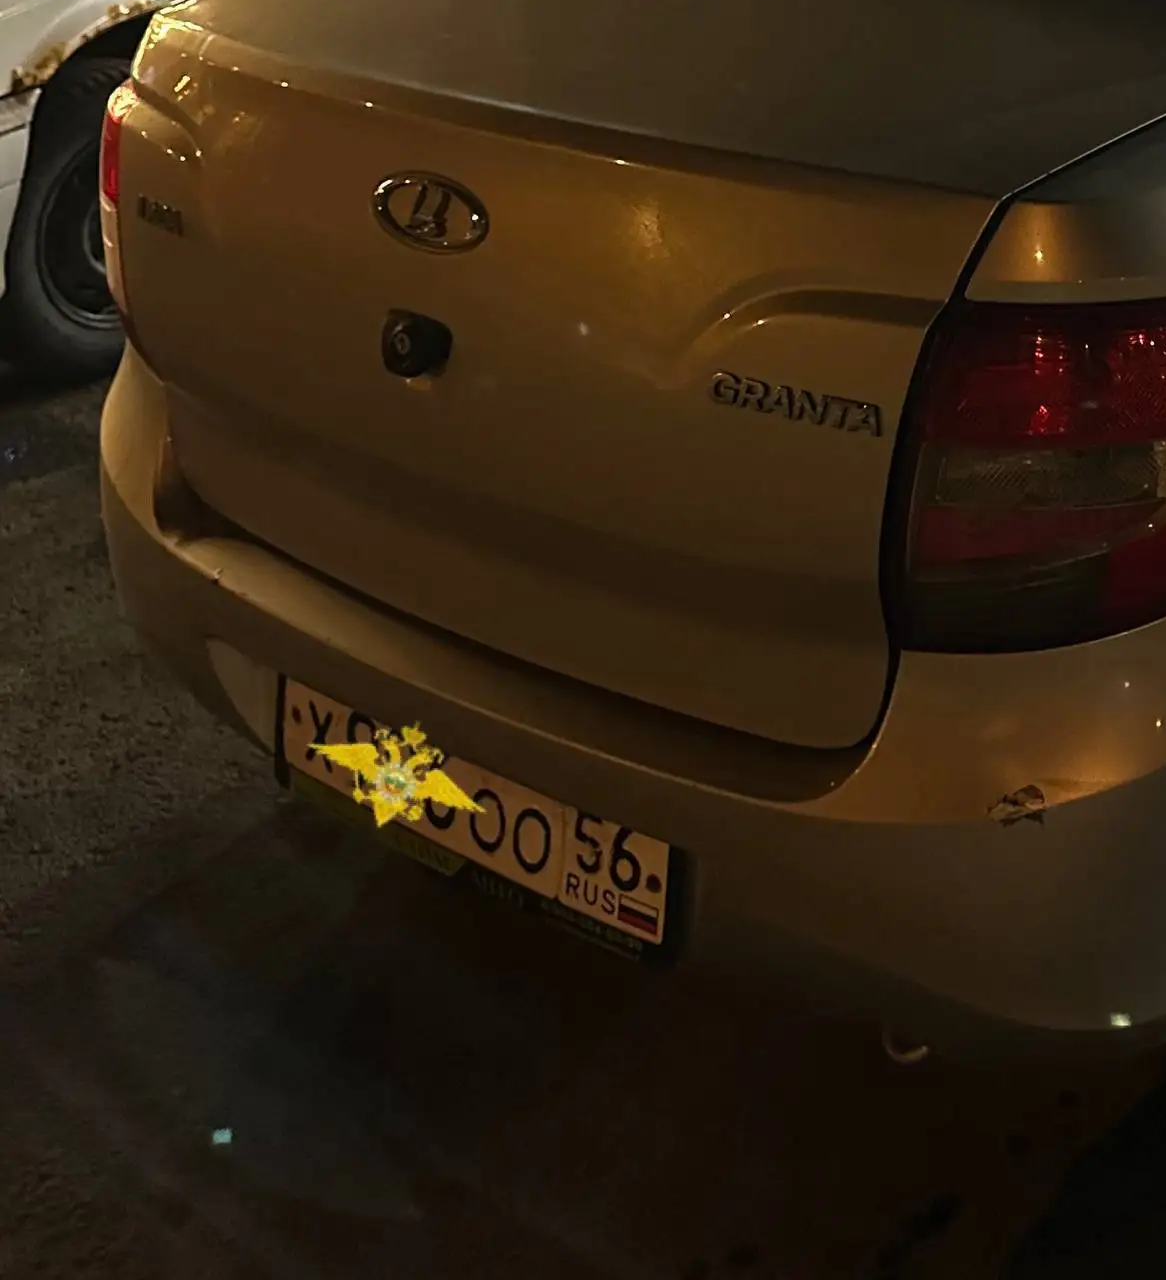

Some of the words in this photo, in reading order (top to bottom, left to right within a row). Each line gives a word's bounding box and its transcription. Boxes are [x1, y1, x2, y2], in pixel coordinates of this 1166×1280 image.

[709, 369, 885, 438] GRANTA
[574, 814, 642, 893] 56
[565, 873, 617, 916] RUS
